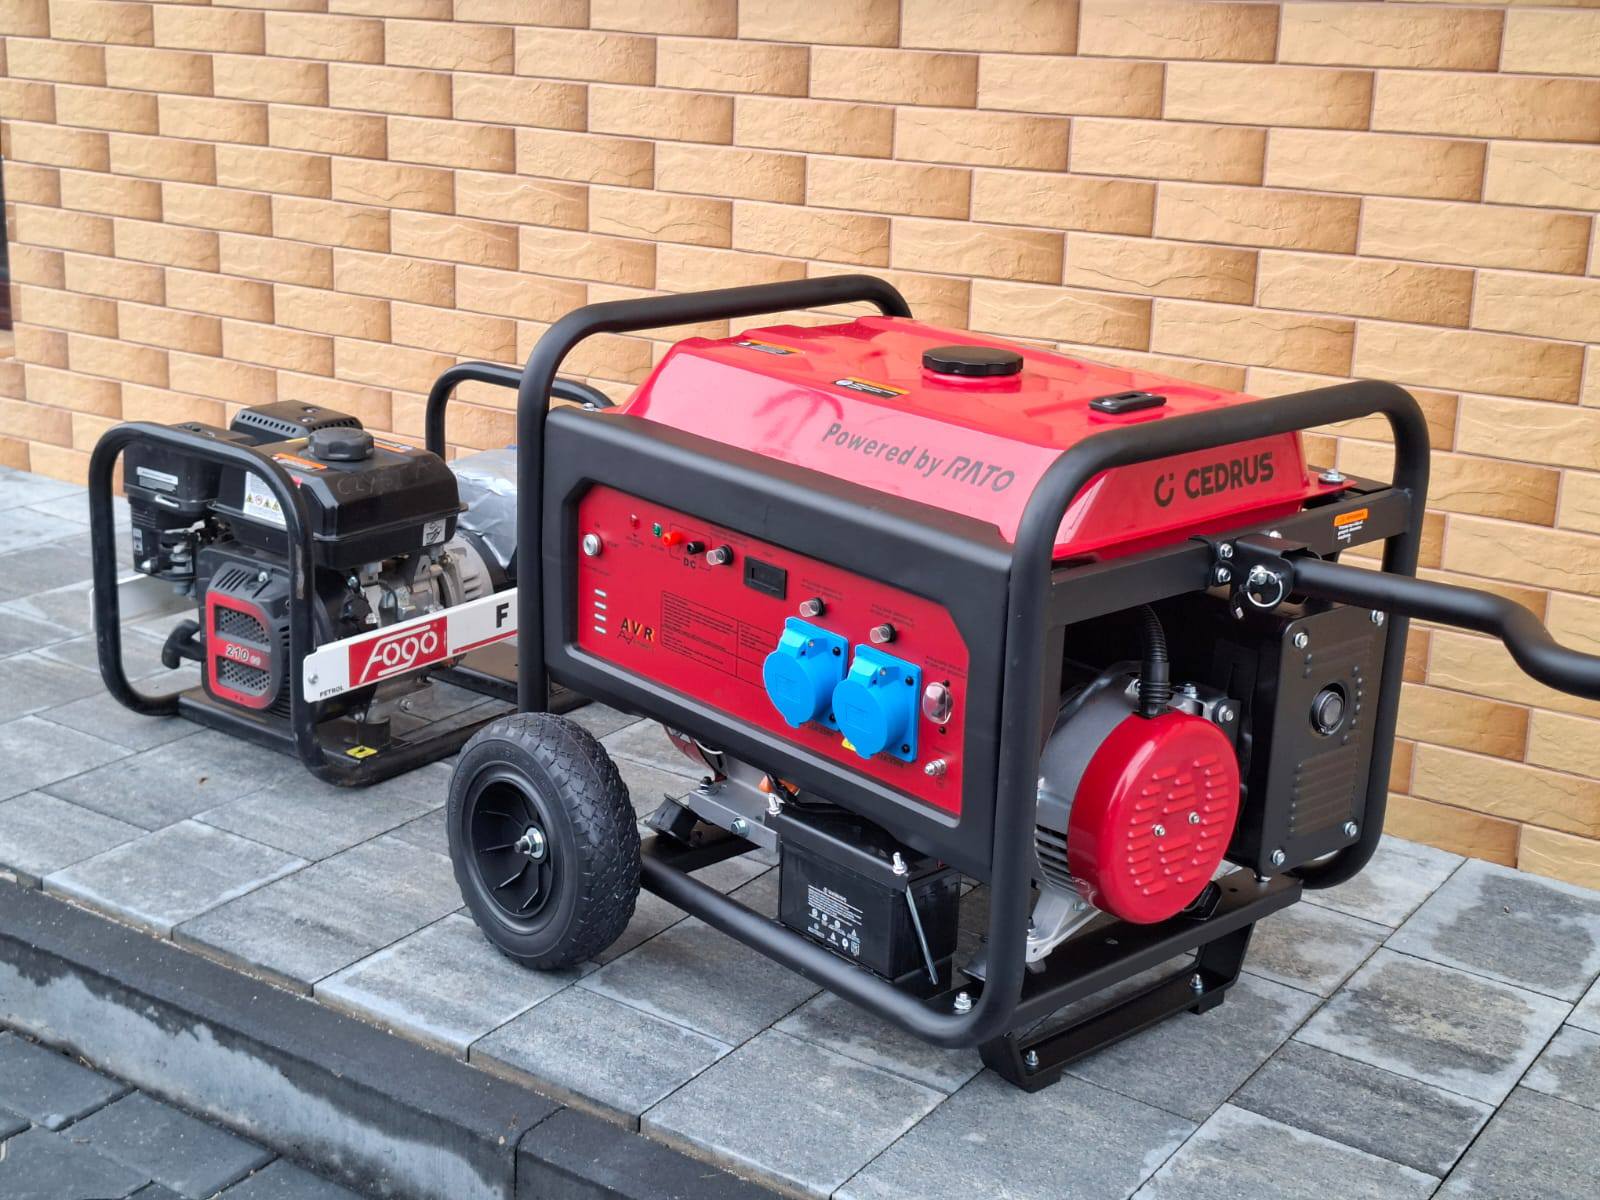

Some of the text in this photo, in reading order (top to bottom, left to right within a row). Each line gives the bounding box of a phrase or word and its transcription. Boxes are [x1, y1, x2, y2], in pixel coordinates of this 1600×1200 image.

[821, 423, 1015, 493] Powered by RATO
[1184, 451, 1274, 499] CEDRUS
[683, 557, 696, 569] DC
[496, 602, 509, 628] F
[621, 617, 655, 642] AVR
[226, 644, 249, 662] 210
[319, 685, 344, 698] PETROL
